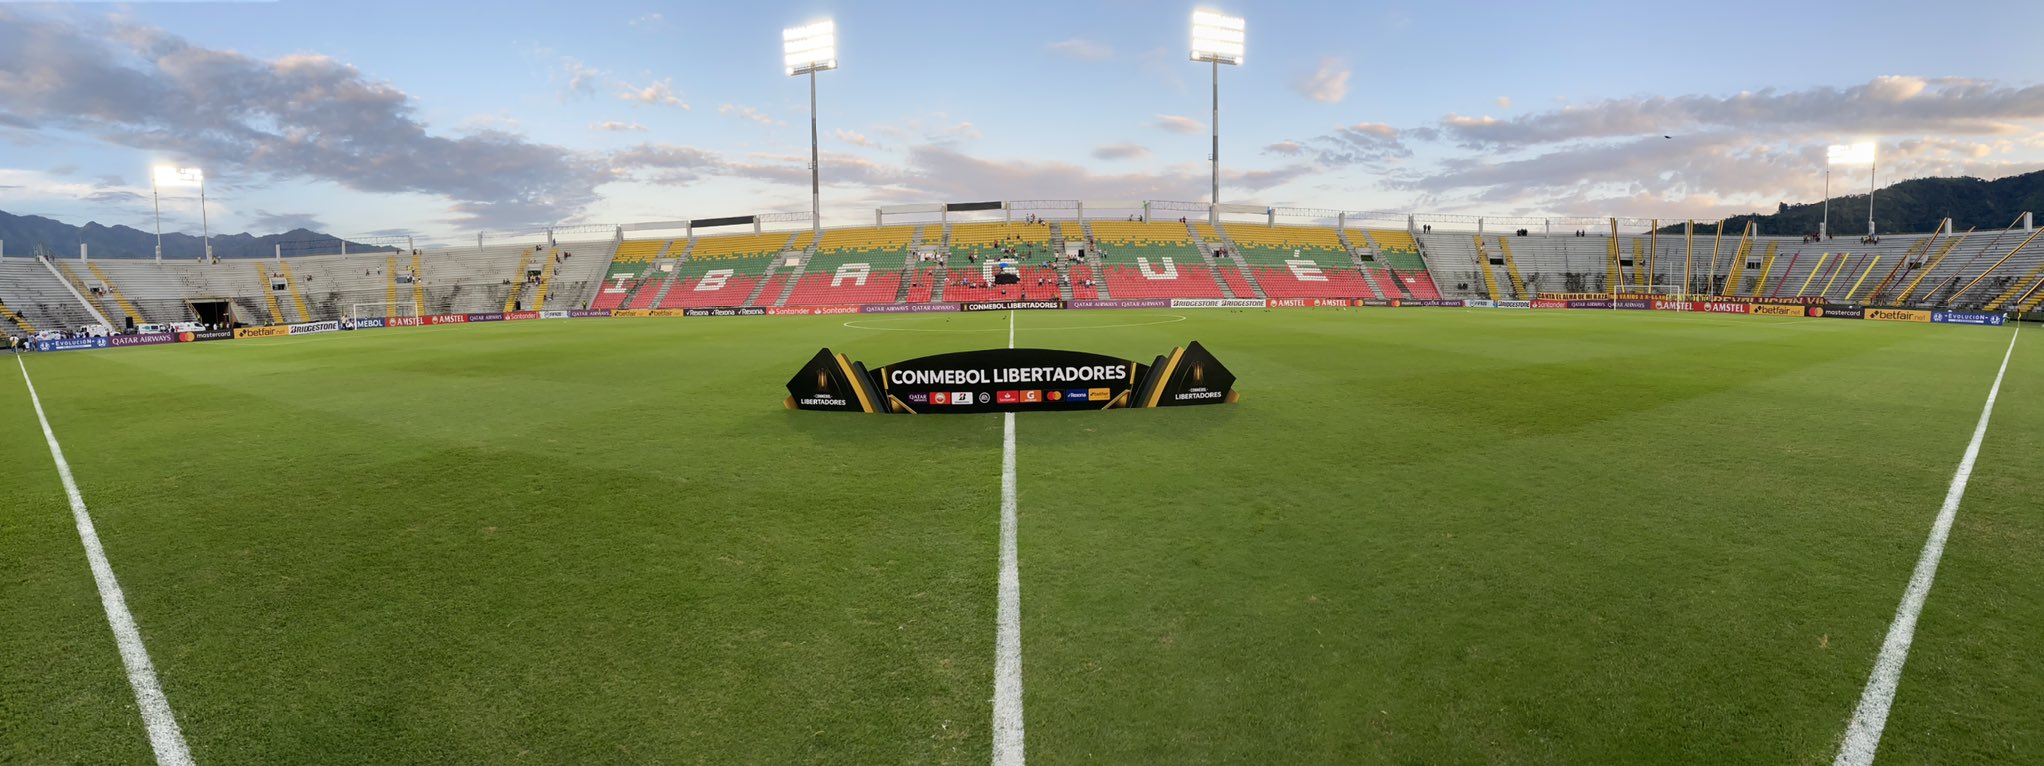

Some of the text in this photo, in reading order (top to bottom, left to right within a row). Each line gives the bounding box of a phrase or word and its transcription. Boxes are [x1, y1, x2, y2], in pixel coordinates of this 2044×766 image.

[1712, 303, 1744, 312] AMSTEL
[398, 316, 424, 325] AMSTEL
[439, 314, 464, 323] AMSTEL
[290, 322, 337, 334] BRIDGESTONE
[112, 334, 171, 345] QATAR AIRWAYS
[891, 364, 1126, 385] CONMEBOL LIBERTADORES
[1175, 392, 1221, 400] LIBERTADORES
